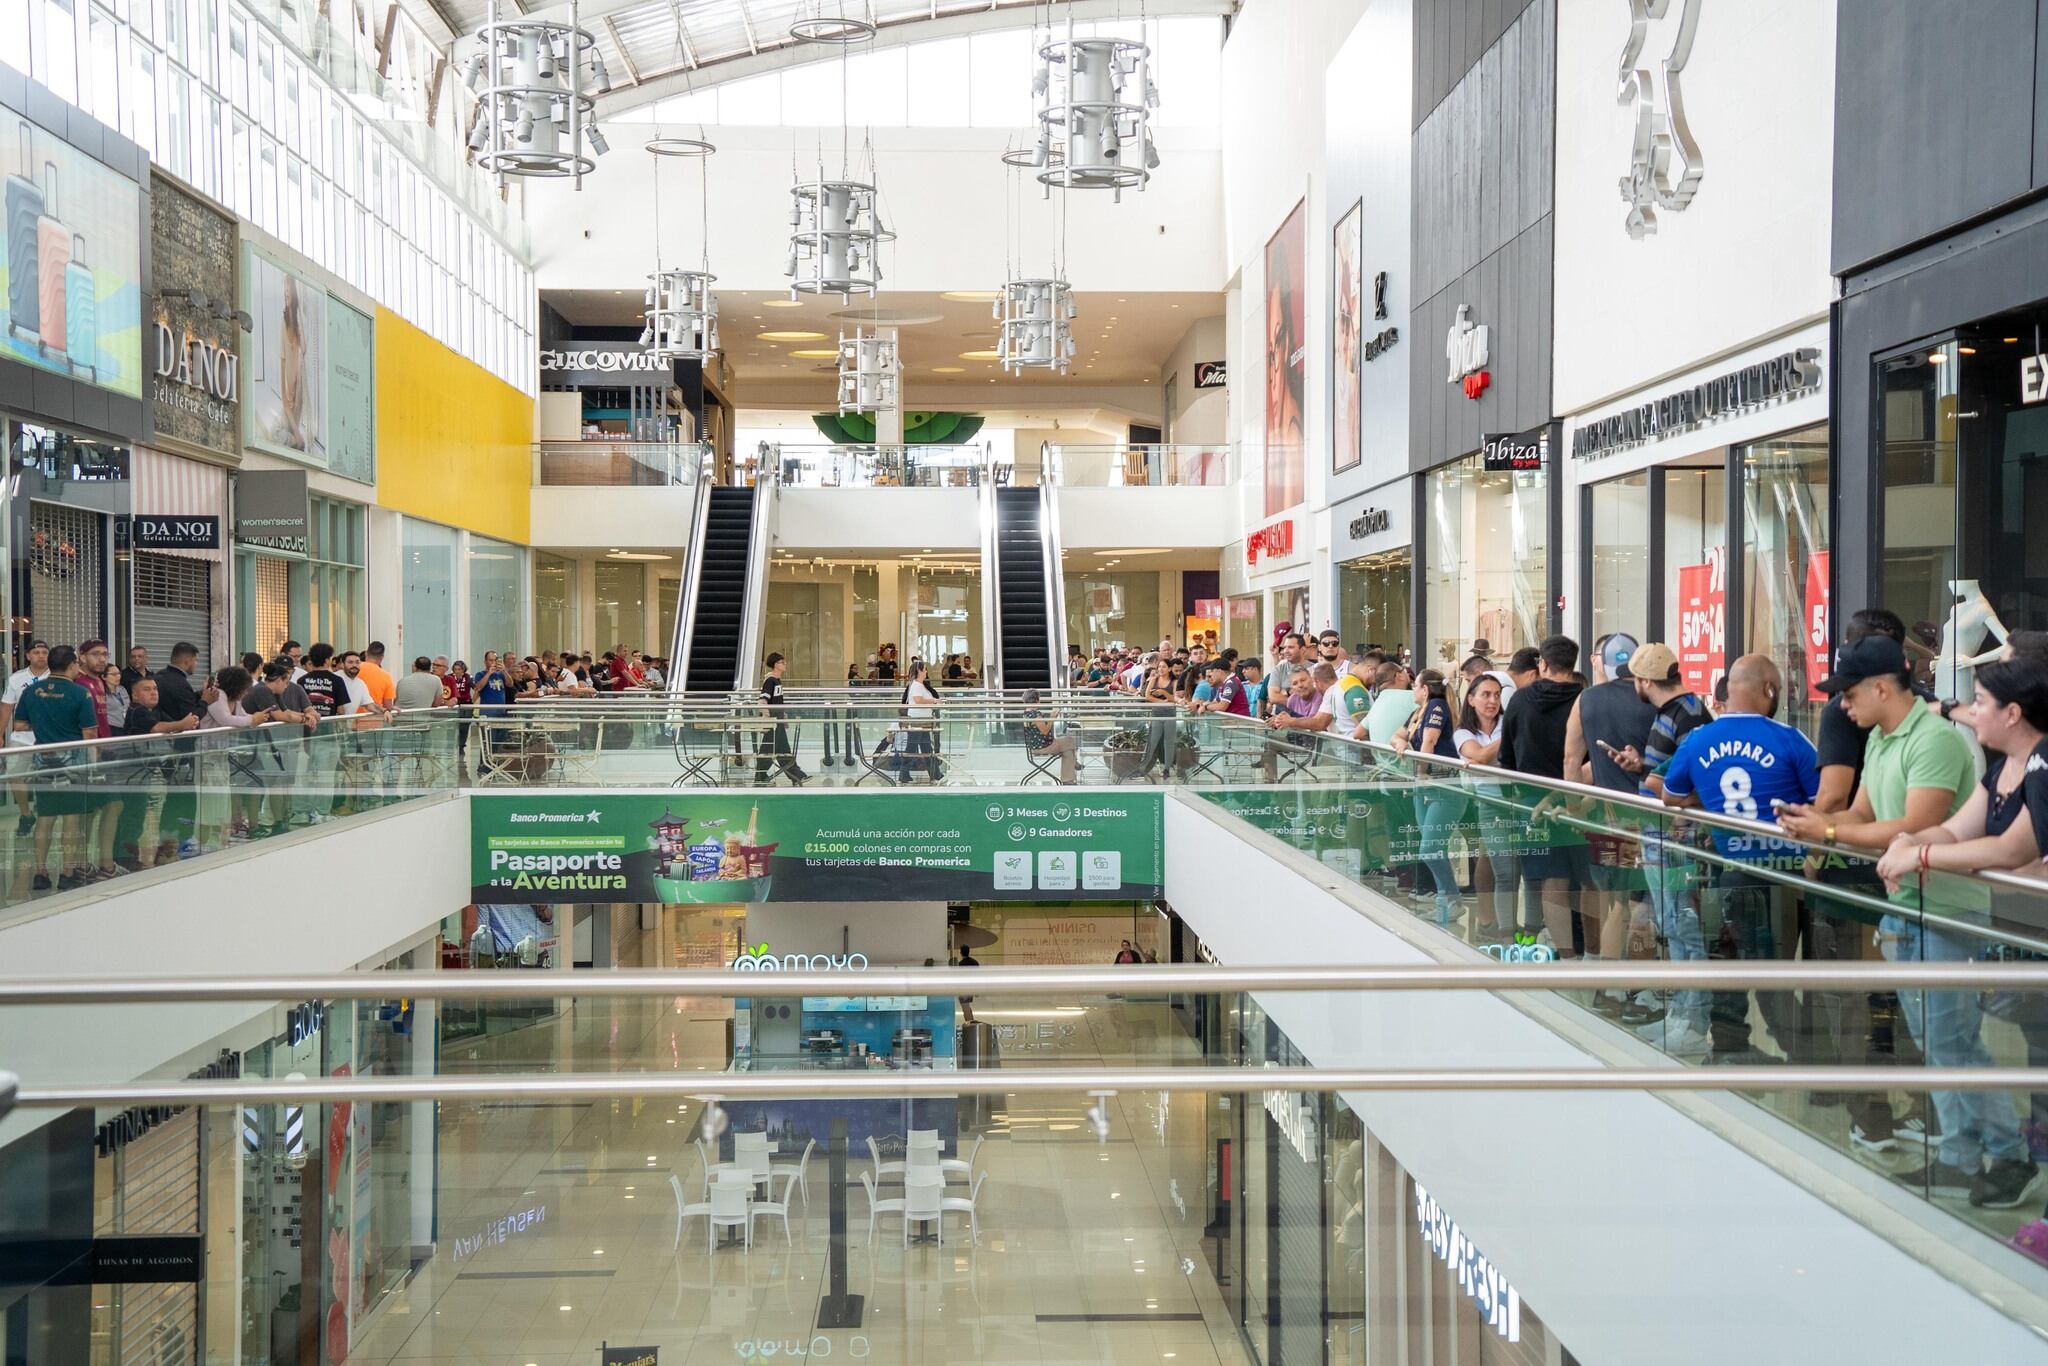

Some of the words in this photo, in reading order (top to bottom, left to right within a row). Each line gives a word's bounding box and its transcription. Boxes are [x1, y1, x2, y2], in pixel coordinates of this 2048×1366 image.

[156, 322, 192, 386] DA
[192, 339, 238, 403] NOI
[1571, 409, 1642, 459] AMERICAN
[1640, 390, 1695, 438] EAGLE
[1692, 347, 1823, 423] OUTFITTERS
[1486, 437, 1538, 460] Ibiza
[142, 522, 170, 536] DA
[176, 522, 212, 536] NOI
[241, 518, 304, 526] women'secret
[1682, 610, 1710, 648] 50%
[1699, 740, 1775, 769] LAMPARD
[1720, 766, 1758, 820] 8
[511, 813, 537, 823] Banco
[539, 812, 584, 823] Promerica
[1007, 808, 1014, 817] 3
[1017, 808, 1048, 817] Meses
[1074, 808, 1081, 817] 3
[1084, 808, 1127, 817] Destinos
[816, 828, 860, 838] Acumulá
[884, 829, 915, 838] acción
[918, 831, 934, 843] por
[937, 829, 960, 838] cada
[1029, 828, 1036, 837] 9
[1039, 828, 1092, 838] Ganadores
[854, 844, 892, 853] colones
[908, 846, 952, 856] compras
[491, 850, 622, 875] Pasaporte
[806, 858, 821, 866] tus
[824, 858, 860, 868] tarjetas
[863, 857, 876, 866] de
[879, 857, 912, 866] Banco
[915, 857, 971, 866] Promerica
[501, 877, 512, 887] la
[512, 871, 627, 890] Aventura
[784, 953, 868, 972] moyo
[98, 1258, 129, 1266] LUNAS
[147, 1256, 193, 1265] ALGODON
